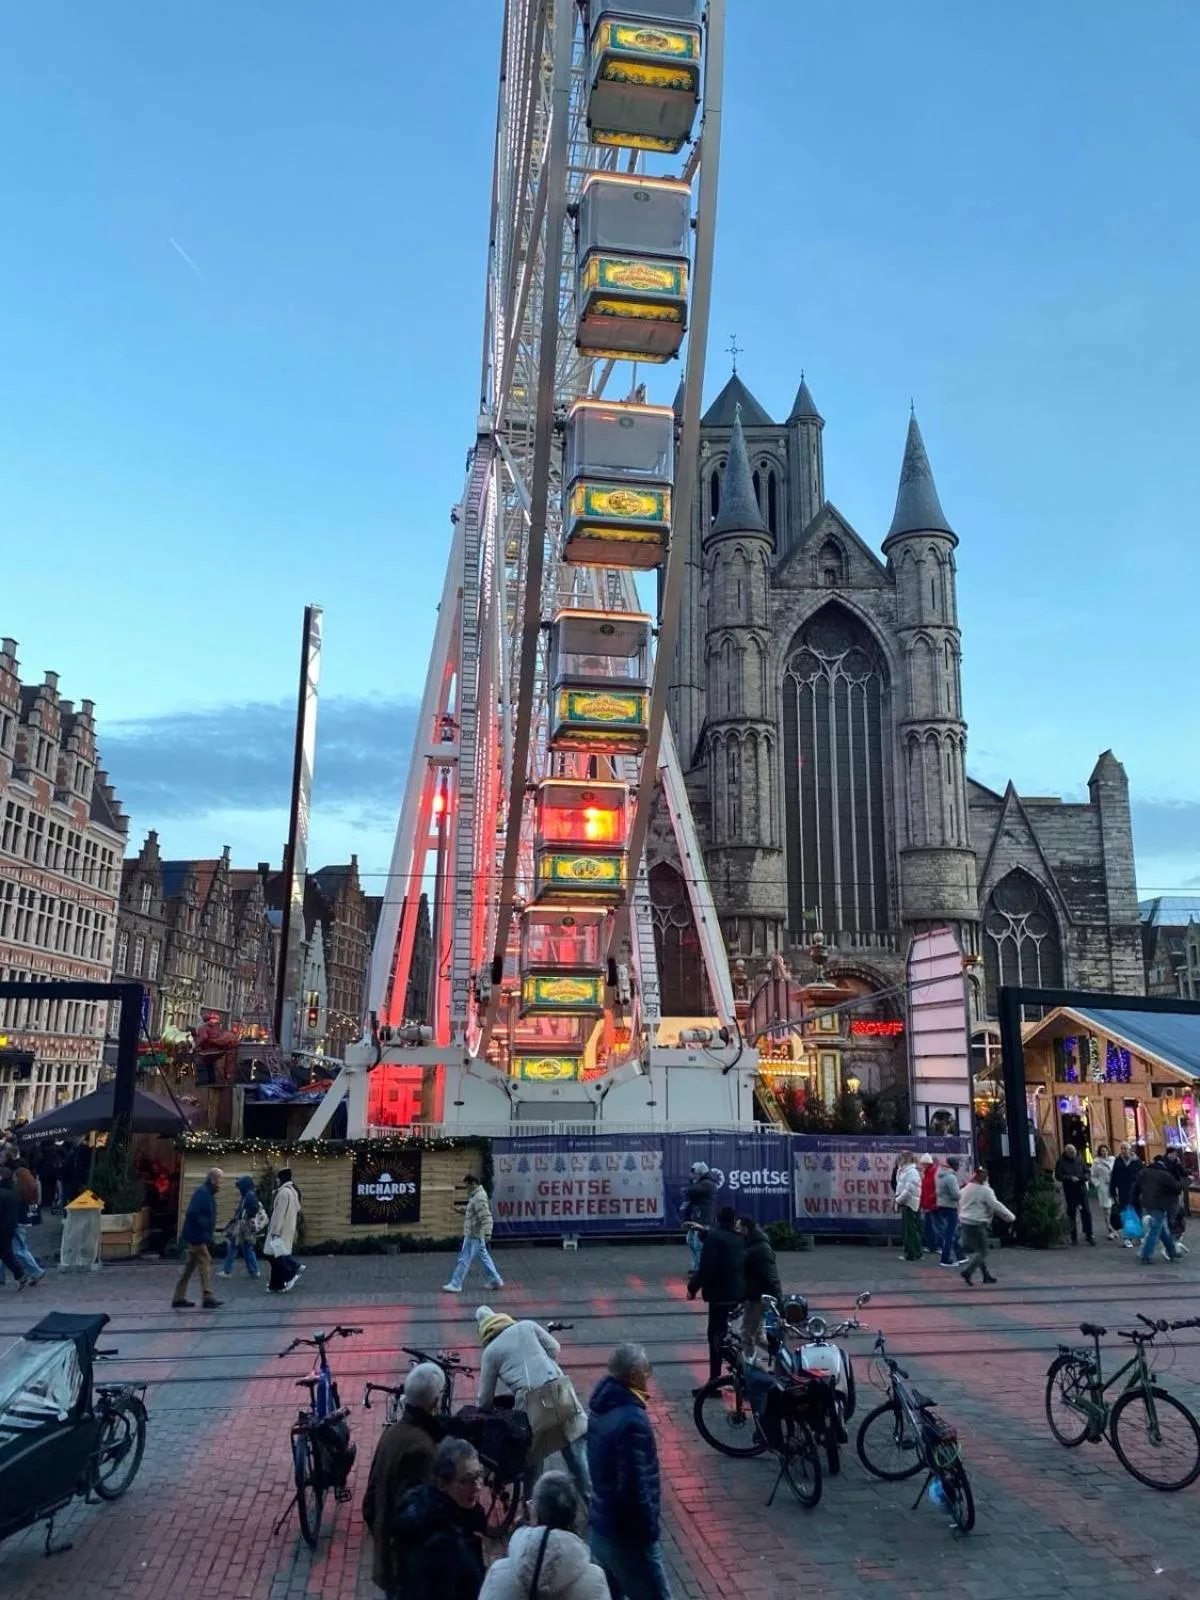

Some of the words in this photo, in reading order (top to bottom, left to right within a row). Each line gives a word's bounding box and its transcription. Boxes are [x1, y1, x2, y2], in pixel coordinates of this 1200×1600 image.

[537, 1179, 611, 1196] GENTSE
[728, 1168, 789, 1190] gentse
[357, 1182, 416, 1195] RICHARD'S
[497, 1198, 657, 1217] WINTERFEESTEN
